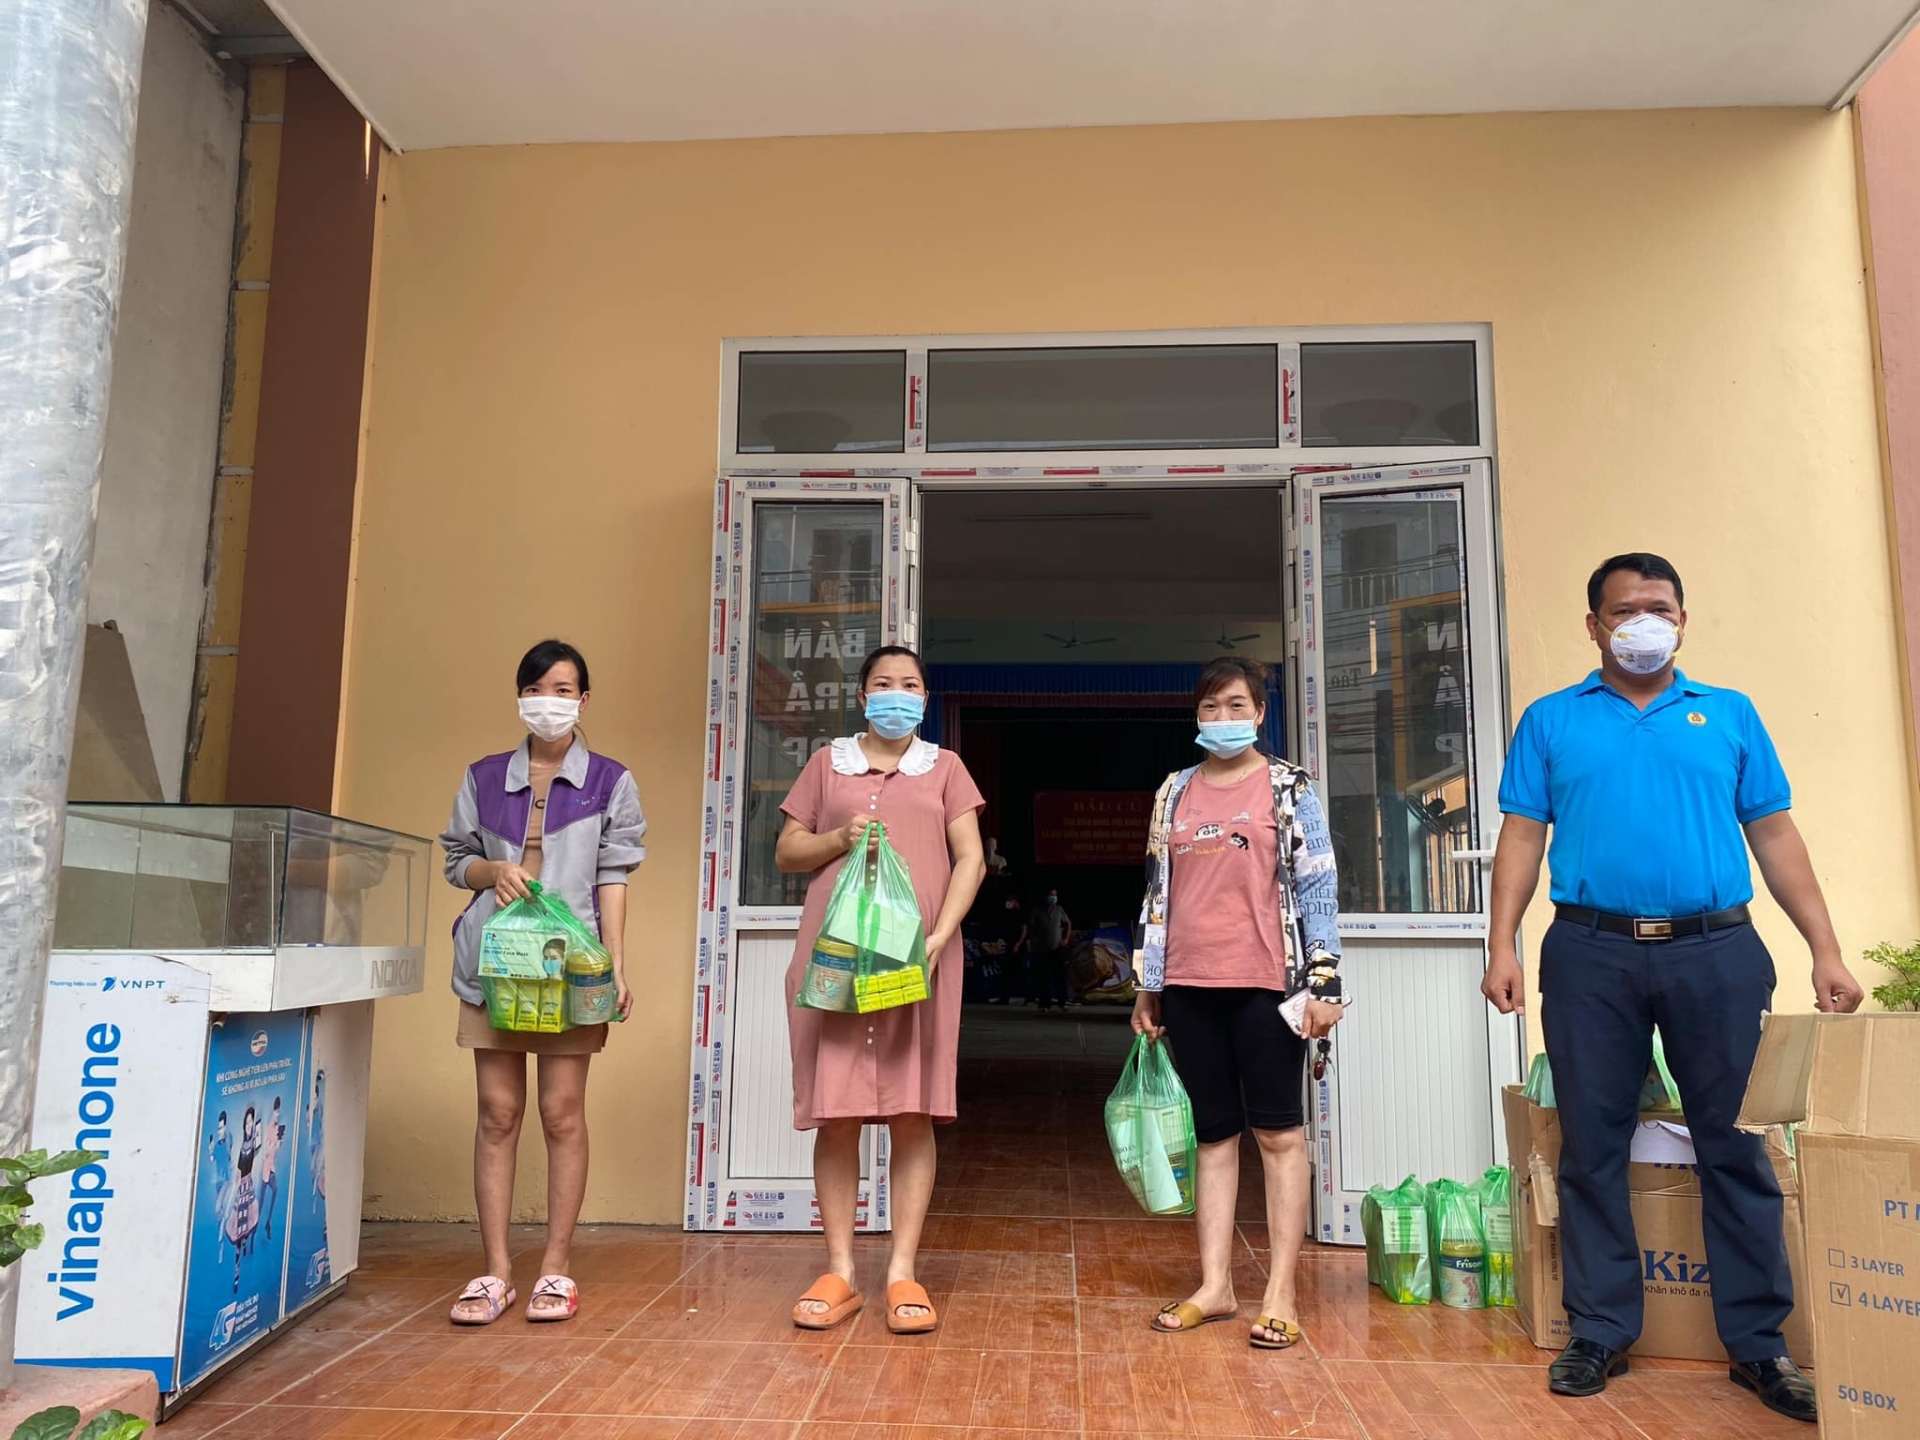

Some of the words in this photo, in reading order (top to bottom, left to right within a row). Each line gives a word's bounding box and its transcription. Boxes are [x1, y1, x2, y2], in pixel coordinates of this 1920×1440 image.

[370, 958, 418, 990] NOKIA
[120, 980, 165, 989] VNPT
[47, 1022, 121, 1321] vinaphone
[1884, 1200, 1909, 1219] PT
[1850, 1256, 1859, 1269] 3
[1862, 1258, 1905, 1277] LAYER
[1689, 1287, 1701, 1297] đa
[1858, 1292, 1869, 1307] 4
[1838, 1384, 1859, 1403] 50
[1863, 1390, 1898, 1412] BOX
